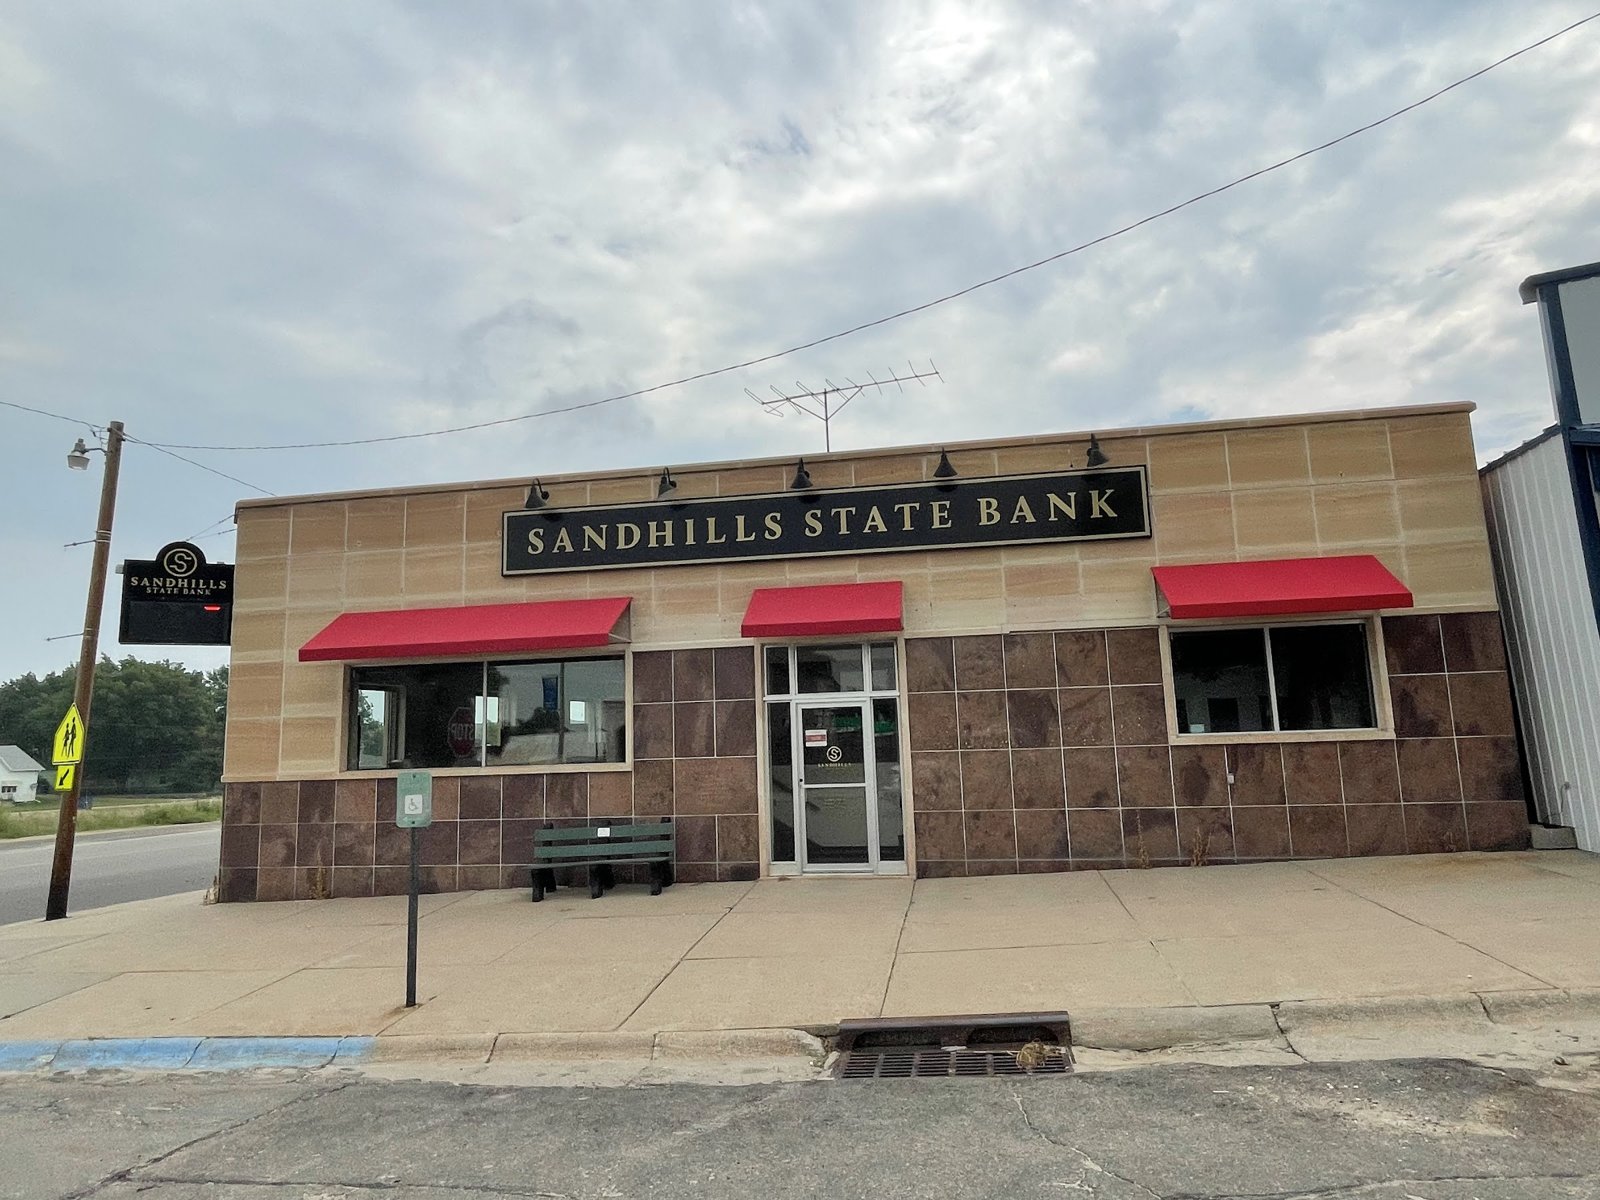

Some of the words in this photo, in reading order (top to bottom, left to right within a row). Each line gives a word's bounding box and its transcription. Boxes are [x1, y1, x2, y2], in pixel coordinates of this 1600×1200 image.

[527, 512, 783, 555] SANDHILLS
[804, 500, 953, 538] STATE
[977, 489, 1118, 526] BANK
[130, 576, 227, 589] SANDHILLS
[146, 587, 179, 595] STATE
[183, 588, 211, 596] BANK
